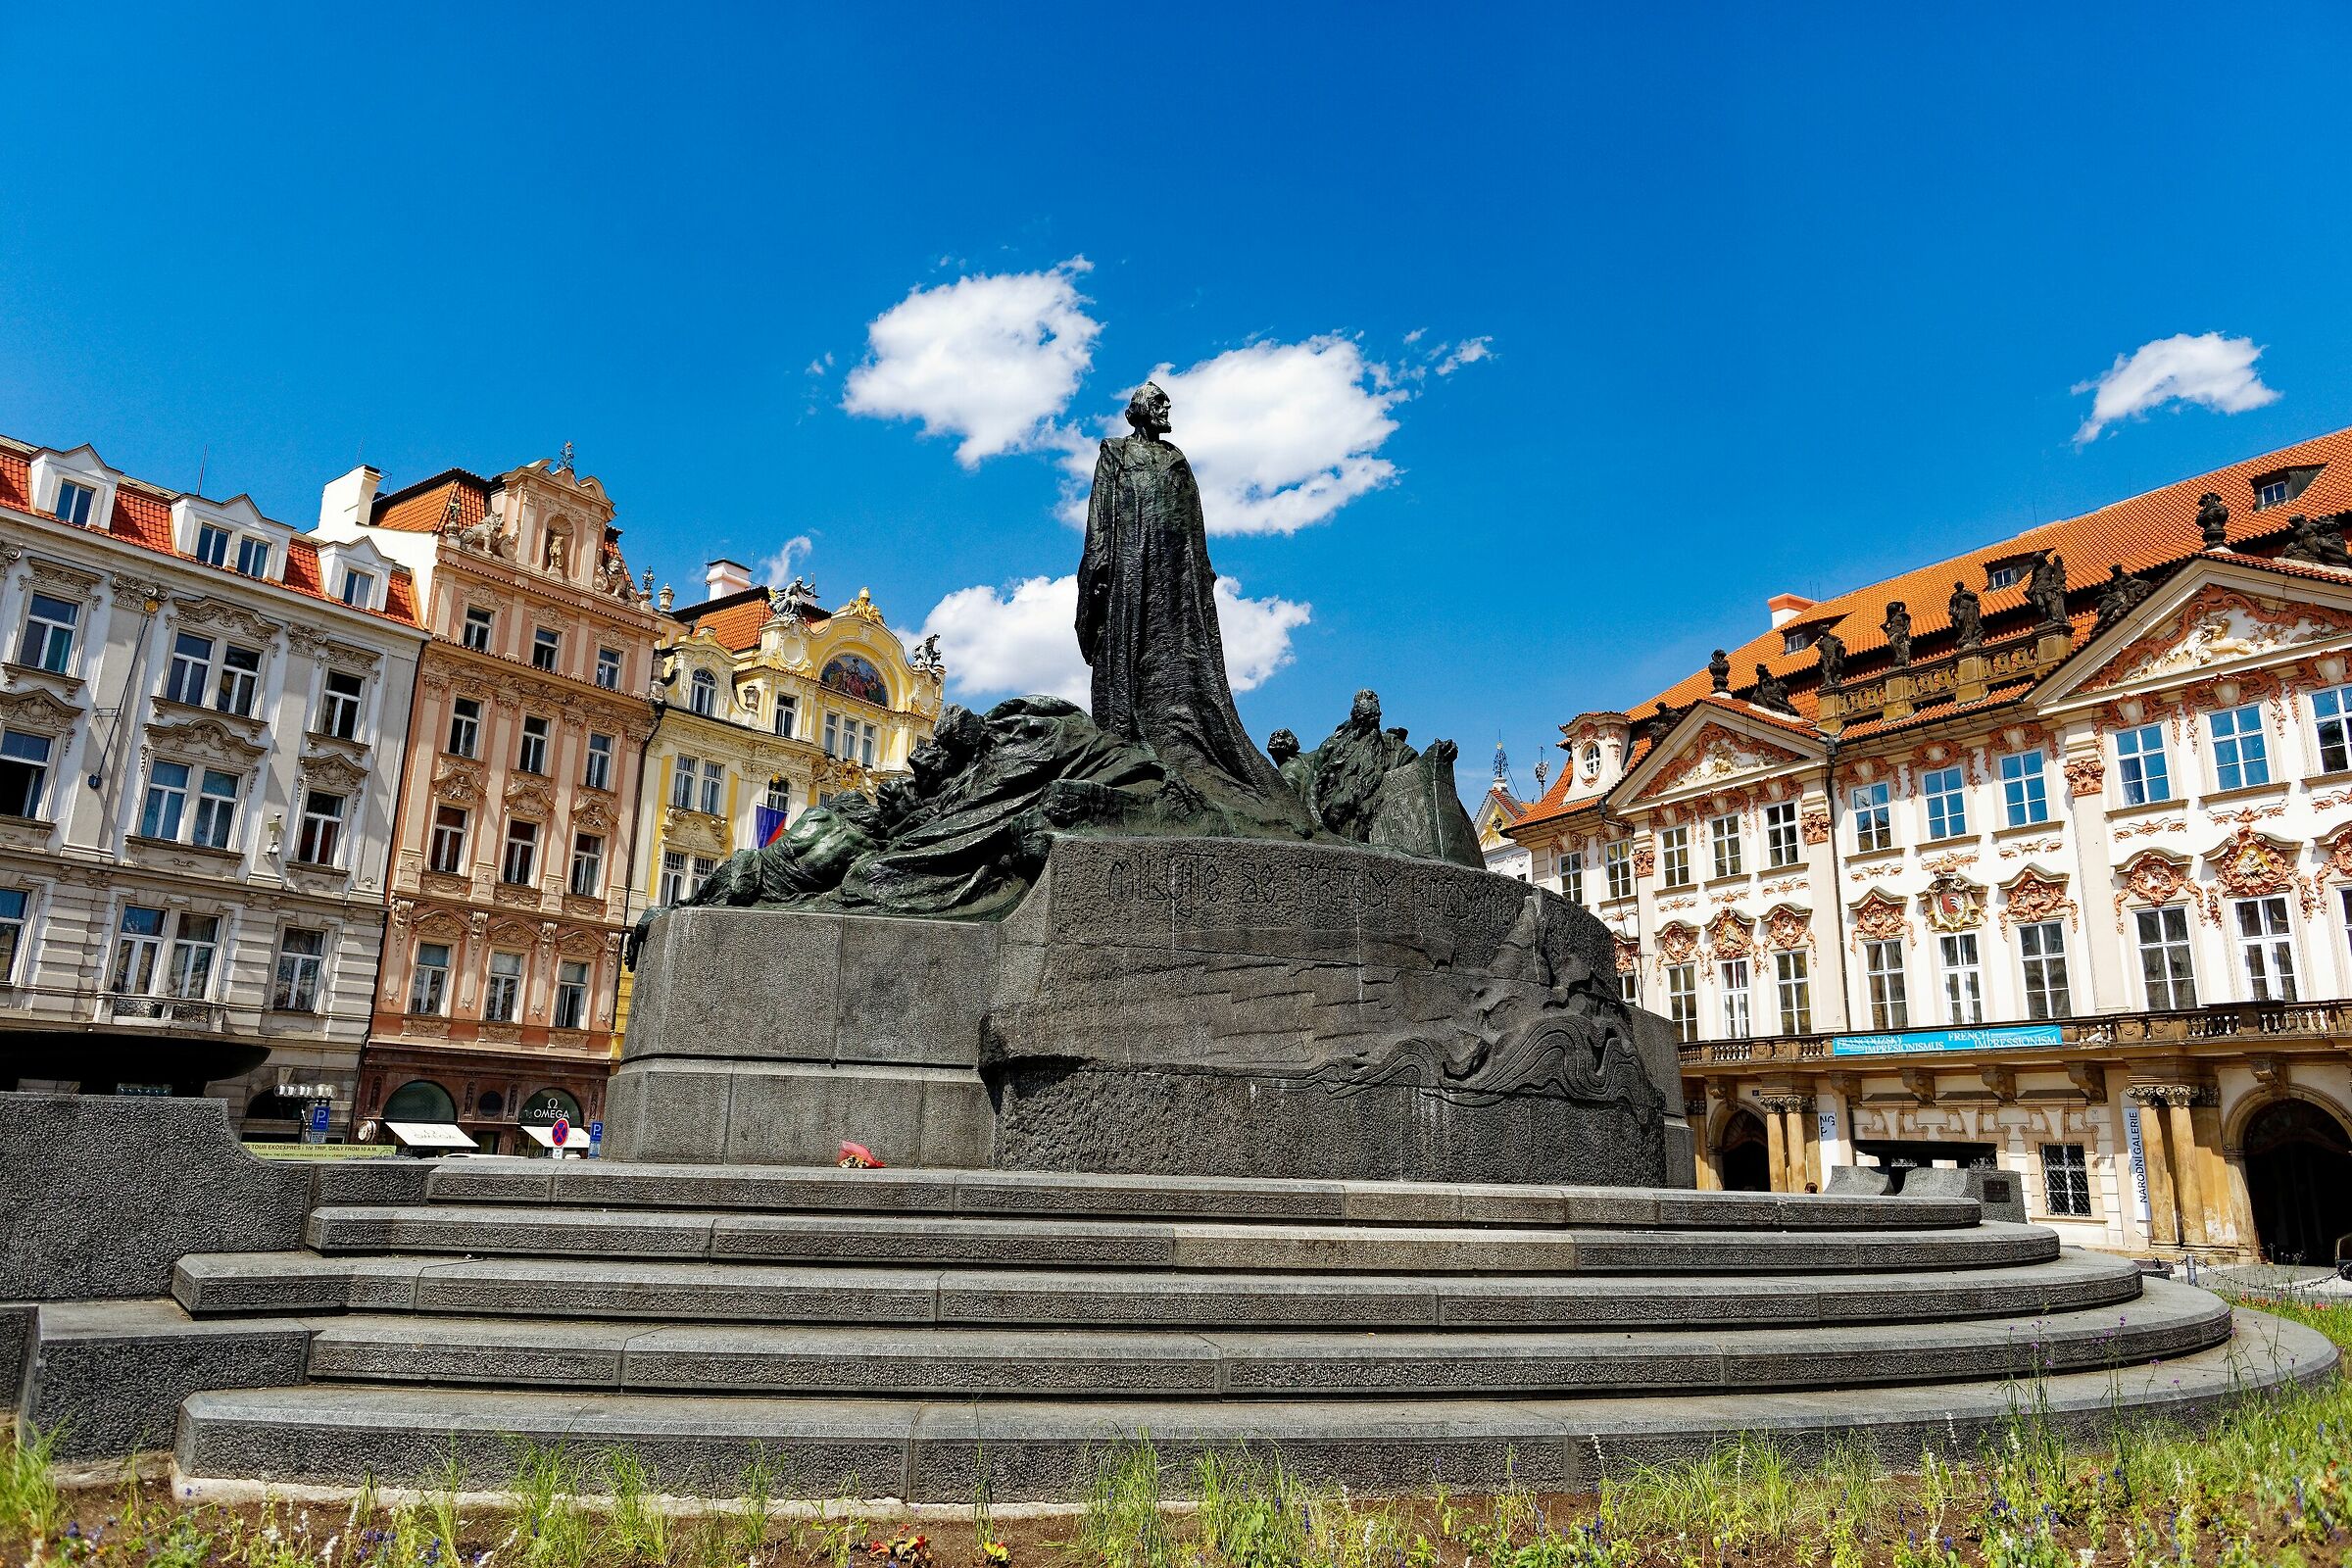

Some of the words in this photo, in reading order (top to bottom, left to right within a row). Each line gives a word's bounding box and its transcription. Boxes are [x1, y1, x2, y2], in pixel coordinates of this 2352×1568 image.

[1948, 1030, 1989, 1041] FRENCH
[1864, 1042, 1944, 1054] IMPRESIONISMUS
[1974, 1036, 2057, 1048] IMPRESSIONISM
[316, 1109, 326, 1123] P
[533, 1109, 569, 1120] OMEGA
[593, 1124, 601, 1135] P
[2129, 1111, 2141, 1155] GALERIE
[2133, 1156, 2148, 1203] NÁRODNÍ
